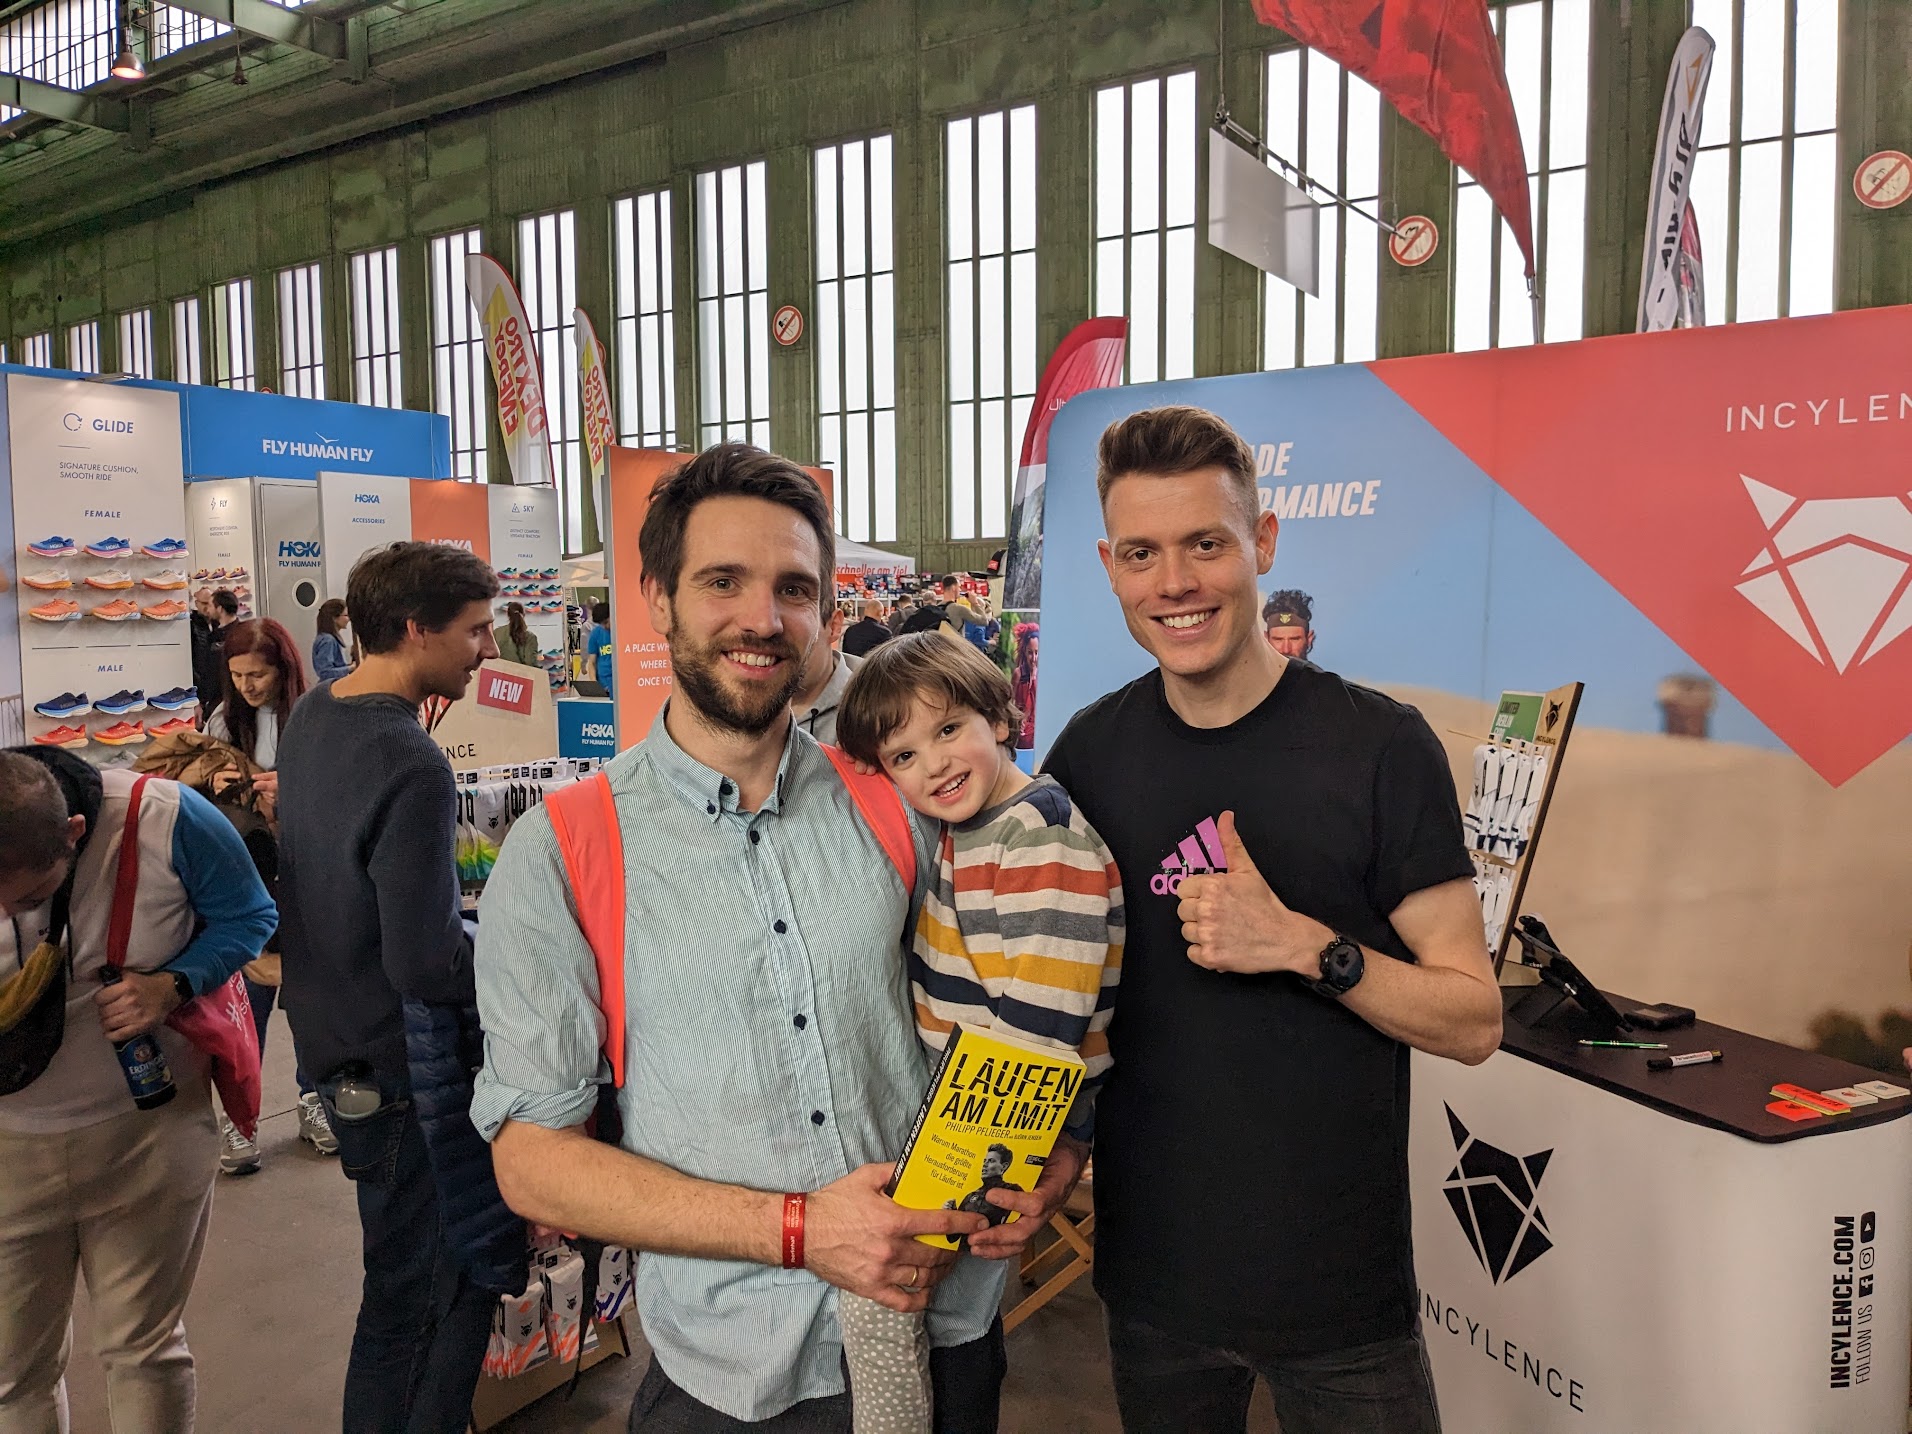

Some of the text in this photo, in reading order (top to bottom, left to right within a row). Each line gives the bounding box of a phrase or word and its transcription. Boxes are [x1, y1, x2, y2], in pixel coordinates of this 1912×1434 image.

[92, 418, 134, 434] GLIDE
[262, 439, 374, 462] FLY HUMAN FLY
[59, 461, 139, 475] SIGNATURE CUSHION,
[1252, 441, 1294, 478] DE
[59, 471, 112, 481] SMOOTH RIDE
[219, 499, 227, 507] FLY
[354, 494, 380, 503] HOKA
[84, 510, 121, 518] FEMALE
[893, 564, 908, 575] Ziel
[624, 643, 631, 653] A
[632, 643, 656, 653] PLACE
[97, 664, 124, 673] MALE
[640, 659, 667, 669] WHERE
[637, 676, 660, 687] ONCE
[488, 677, 524, 704] NEW
[581, 723, 615, 738] HOKA
[949, 1053, 1082, 1103] LAUFEN
[939, 1091, 1066, 1131] AM LIMIT
[945, 1121, 975, 1134] PHILIPP
[976, 1127, 1010, 1139] PFLIEGER
[894, 1104, 927, 1182] LAUFEN AM LIMIT
[931, 1133, 976, 1159] Warum Marathon
[924, 1154, 968, 1181] Herausforderung
[945, 1152, 972, 1169] die größte
[930, 1169, 964, 1189] für Läufer ist
[1830, 1216, 1855, 1389] INCYLENCE.COM
[1418, 1288, 1584, 1413] INCYLENCE
[1856, 1304, 1873, 1385] FOLLOW US
